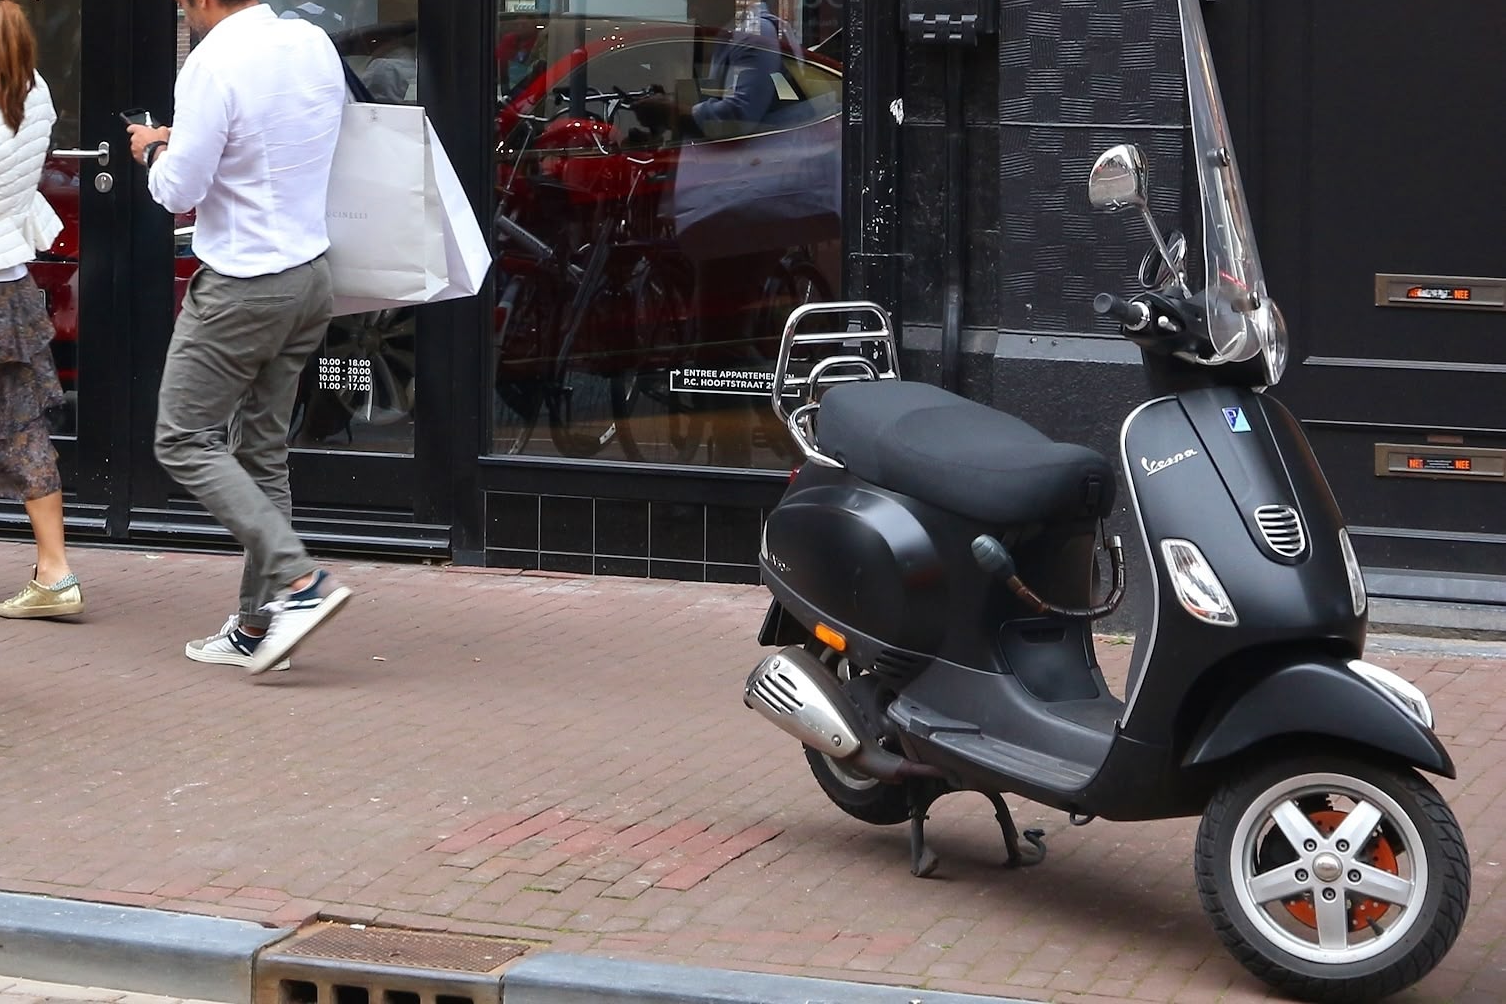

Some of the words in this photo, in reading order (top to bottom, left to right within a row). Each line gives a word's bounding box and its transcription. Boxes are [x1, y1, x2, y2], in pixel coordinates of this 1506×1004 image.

[318, 357, 341, 366] 10.00
[348, 359, 371, 367] 18.00
[318, 366, 341, 374] 10.00
[347, 367, 371, 375] 20.00
[683, 369, 717, 378] ENTREE
[318, 374, 341, 382] 10.00
[348, 375, 371, 383] 17.00
[683, 377, 698, 386] P.C.
[700, 378, 763, 389] HOOFTSTRAAT
[318, 382, 341, 390] 11.00
[348, 383, 371, 392] 17.00
[1140, 448, 1198, 476] Vespa
[1455, 460, 1470, 470] NEE
